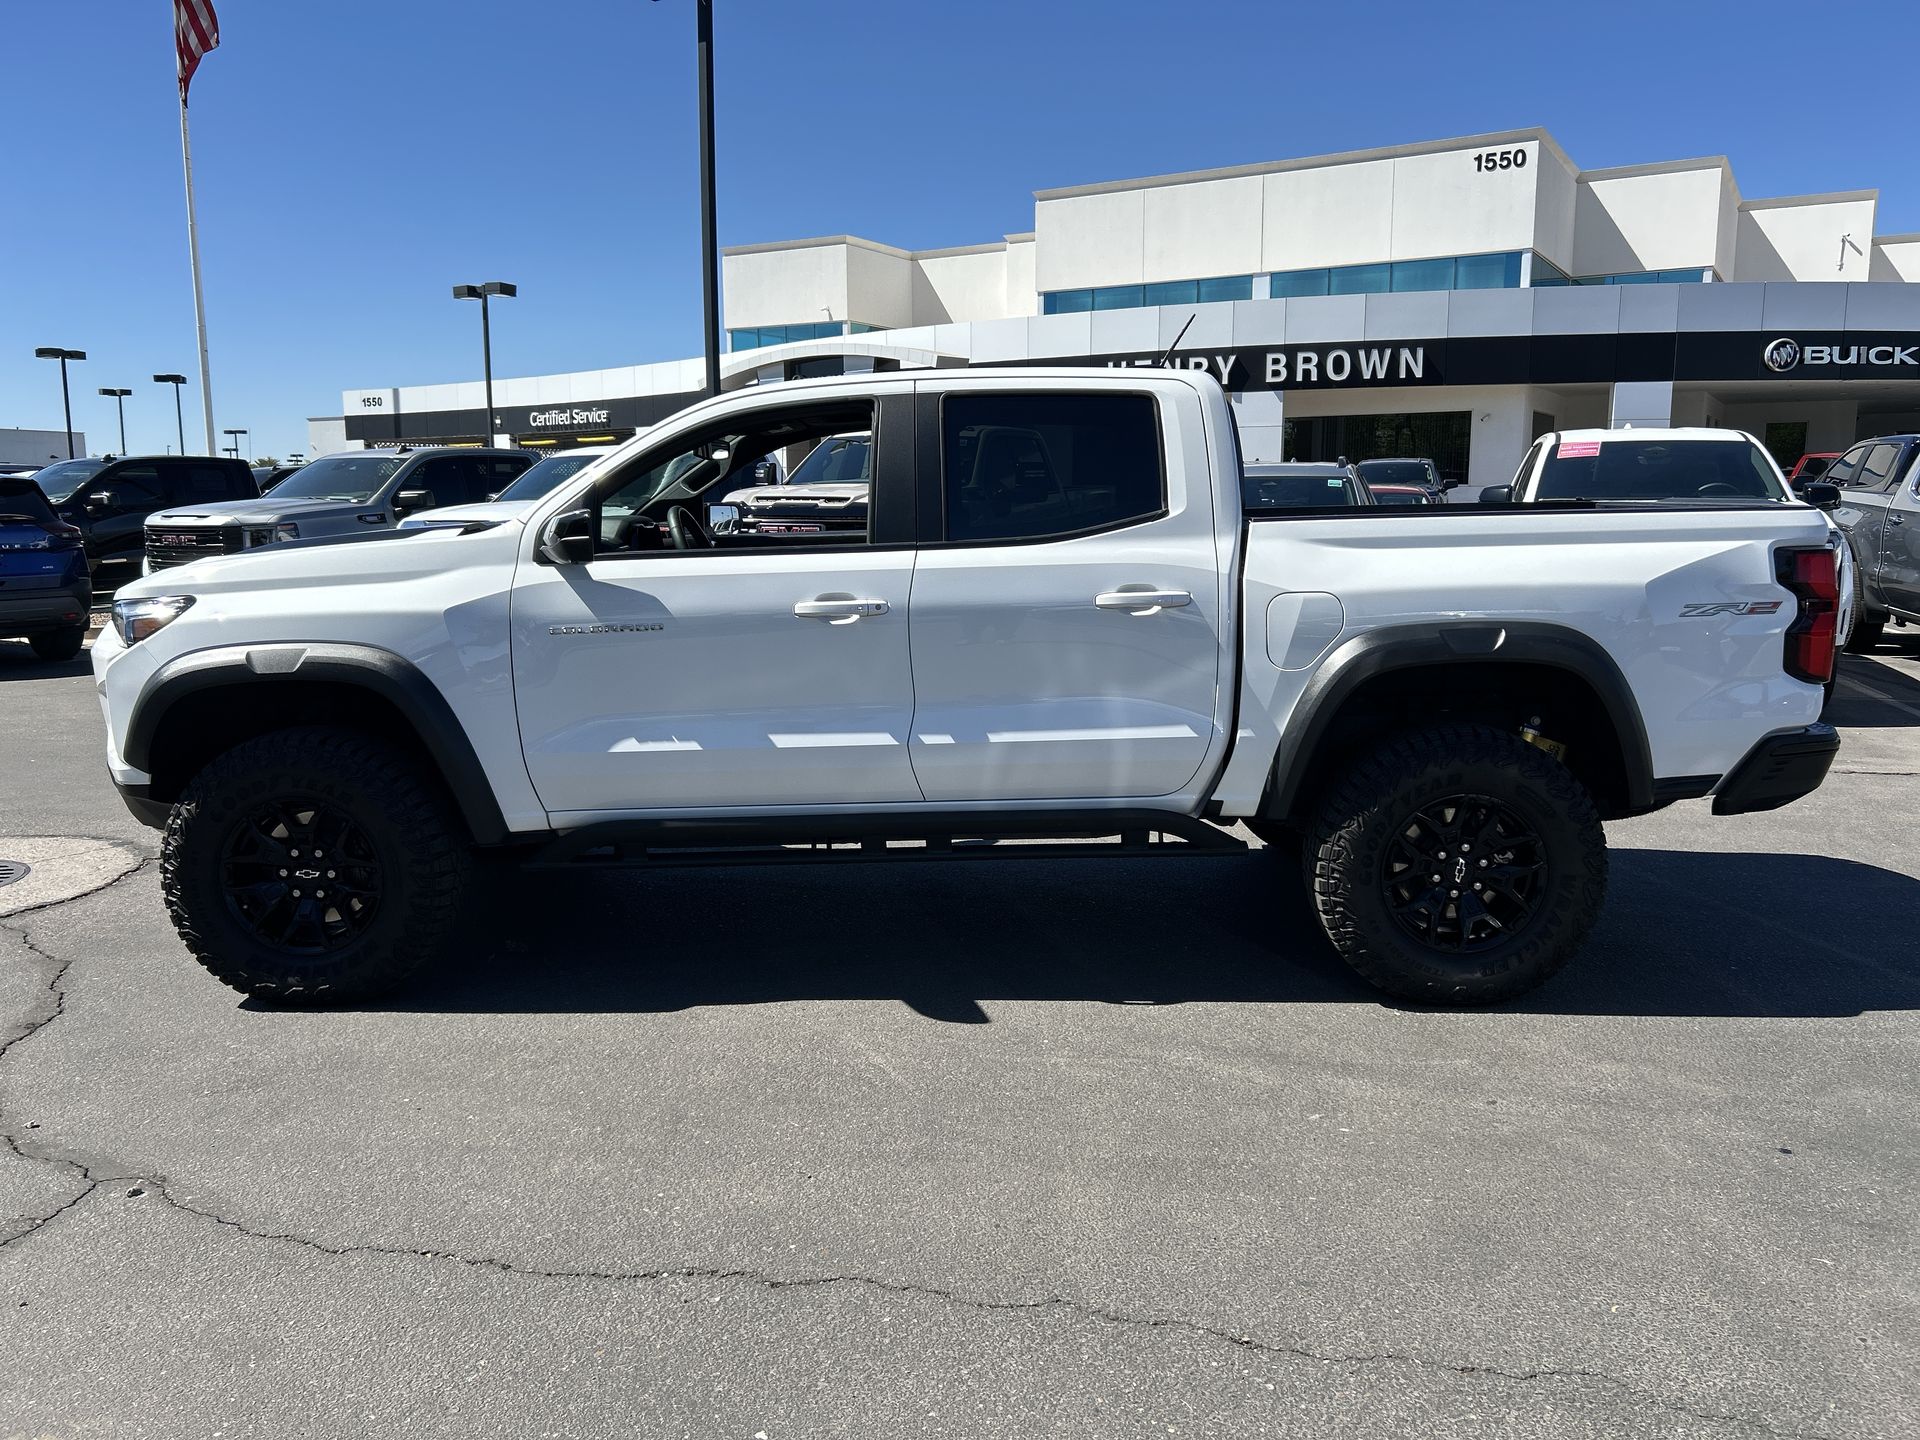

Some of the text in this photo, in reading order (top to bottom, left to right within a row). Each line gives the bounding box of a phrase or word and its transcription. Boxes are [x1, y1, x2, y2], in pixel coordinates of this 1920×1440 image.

[1473, 149, 1527, 172] 1550
[1803, 346, 1919, 365] BUICK
[1265, 347, 1425, 384] BROWN
[362, 397, 383, 408] 1550
[529, 407, 608, 427] Certified Service
[161, 535, 197, 546] GMC
[1678, 600, 1784, 617] ZR2
[548, 623, 664, 635] COLORADO
